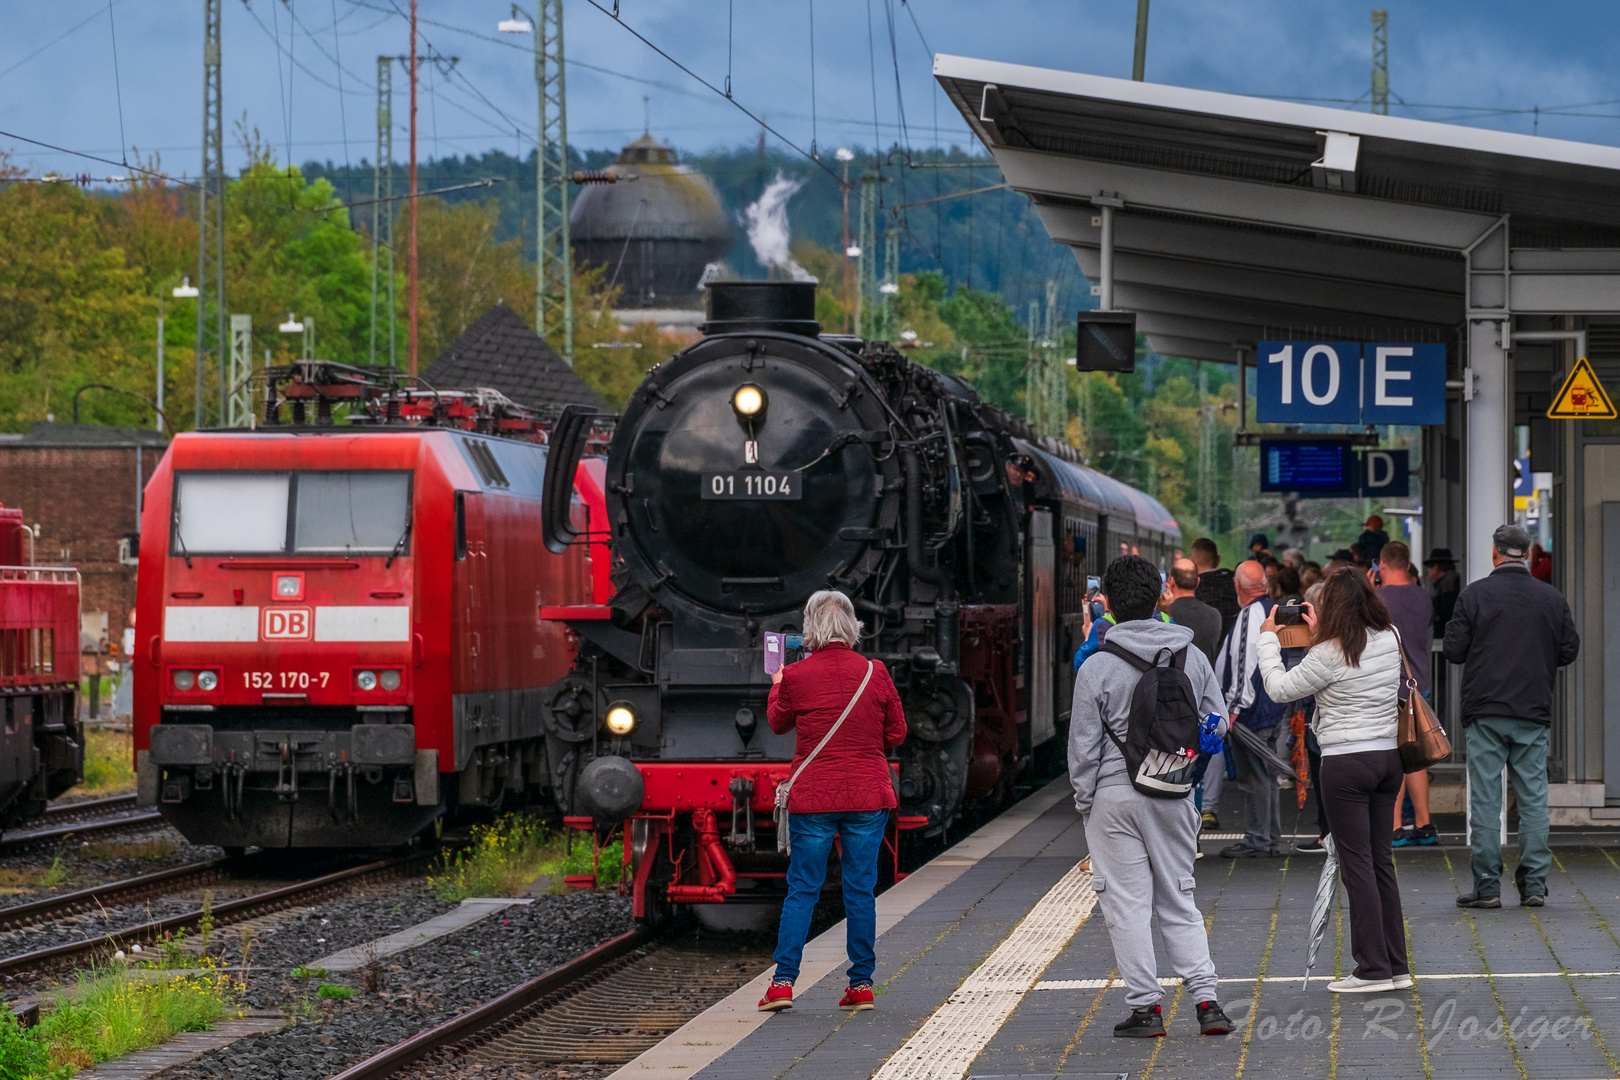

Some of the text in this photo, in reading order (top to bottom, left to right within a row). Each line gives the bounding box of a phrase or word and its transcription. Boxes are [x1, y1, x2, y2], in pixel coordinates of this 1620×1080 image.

[1268, 344, 1341, 406] 10
[1375, 346, 1414, 406] E
[1367, 451, 1394, 488] D
[711, 475, 791, 495] 01 1104
[269, 613, 306, 635] DB
[243, 672, 330, 689] 152 170-7
